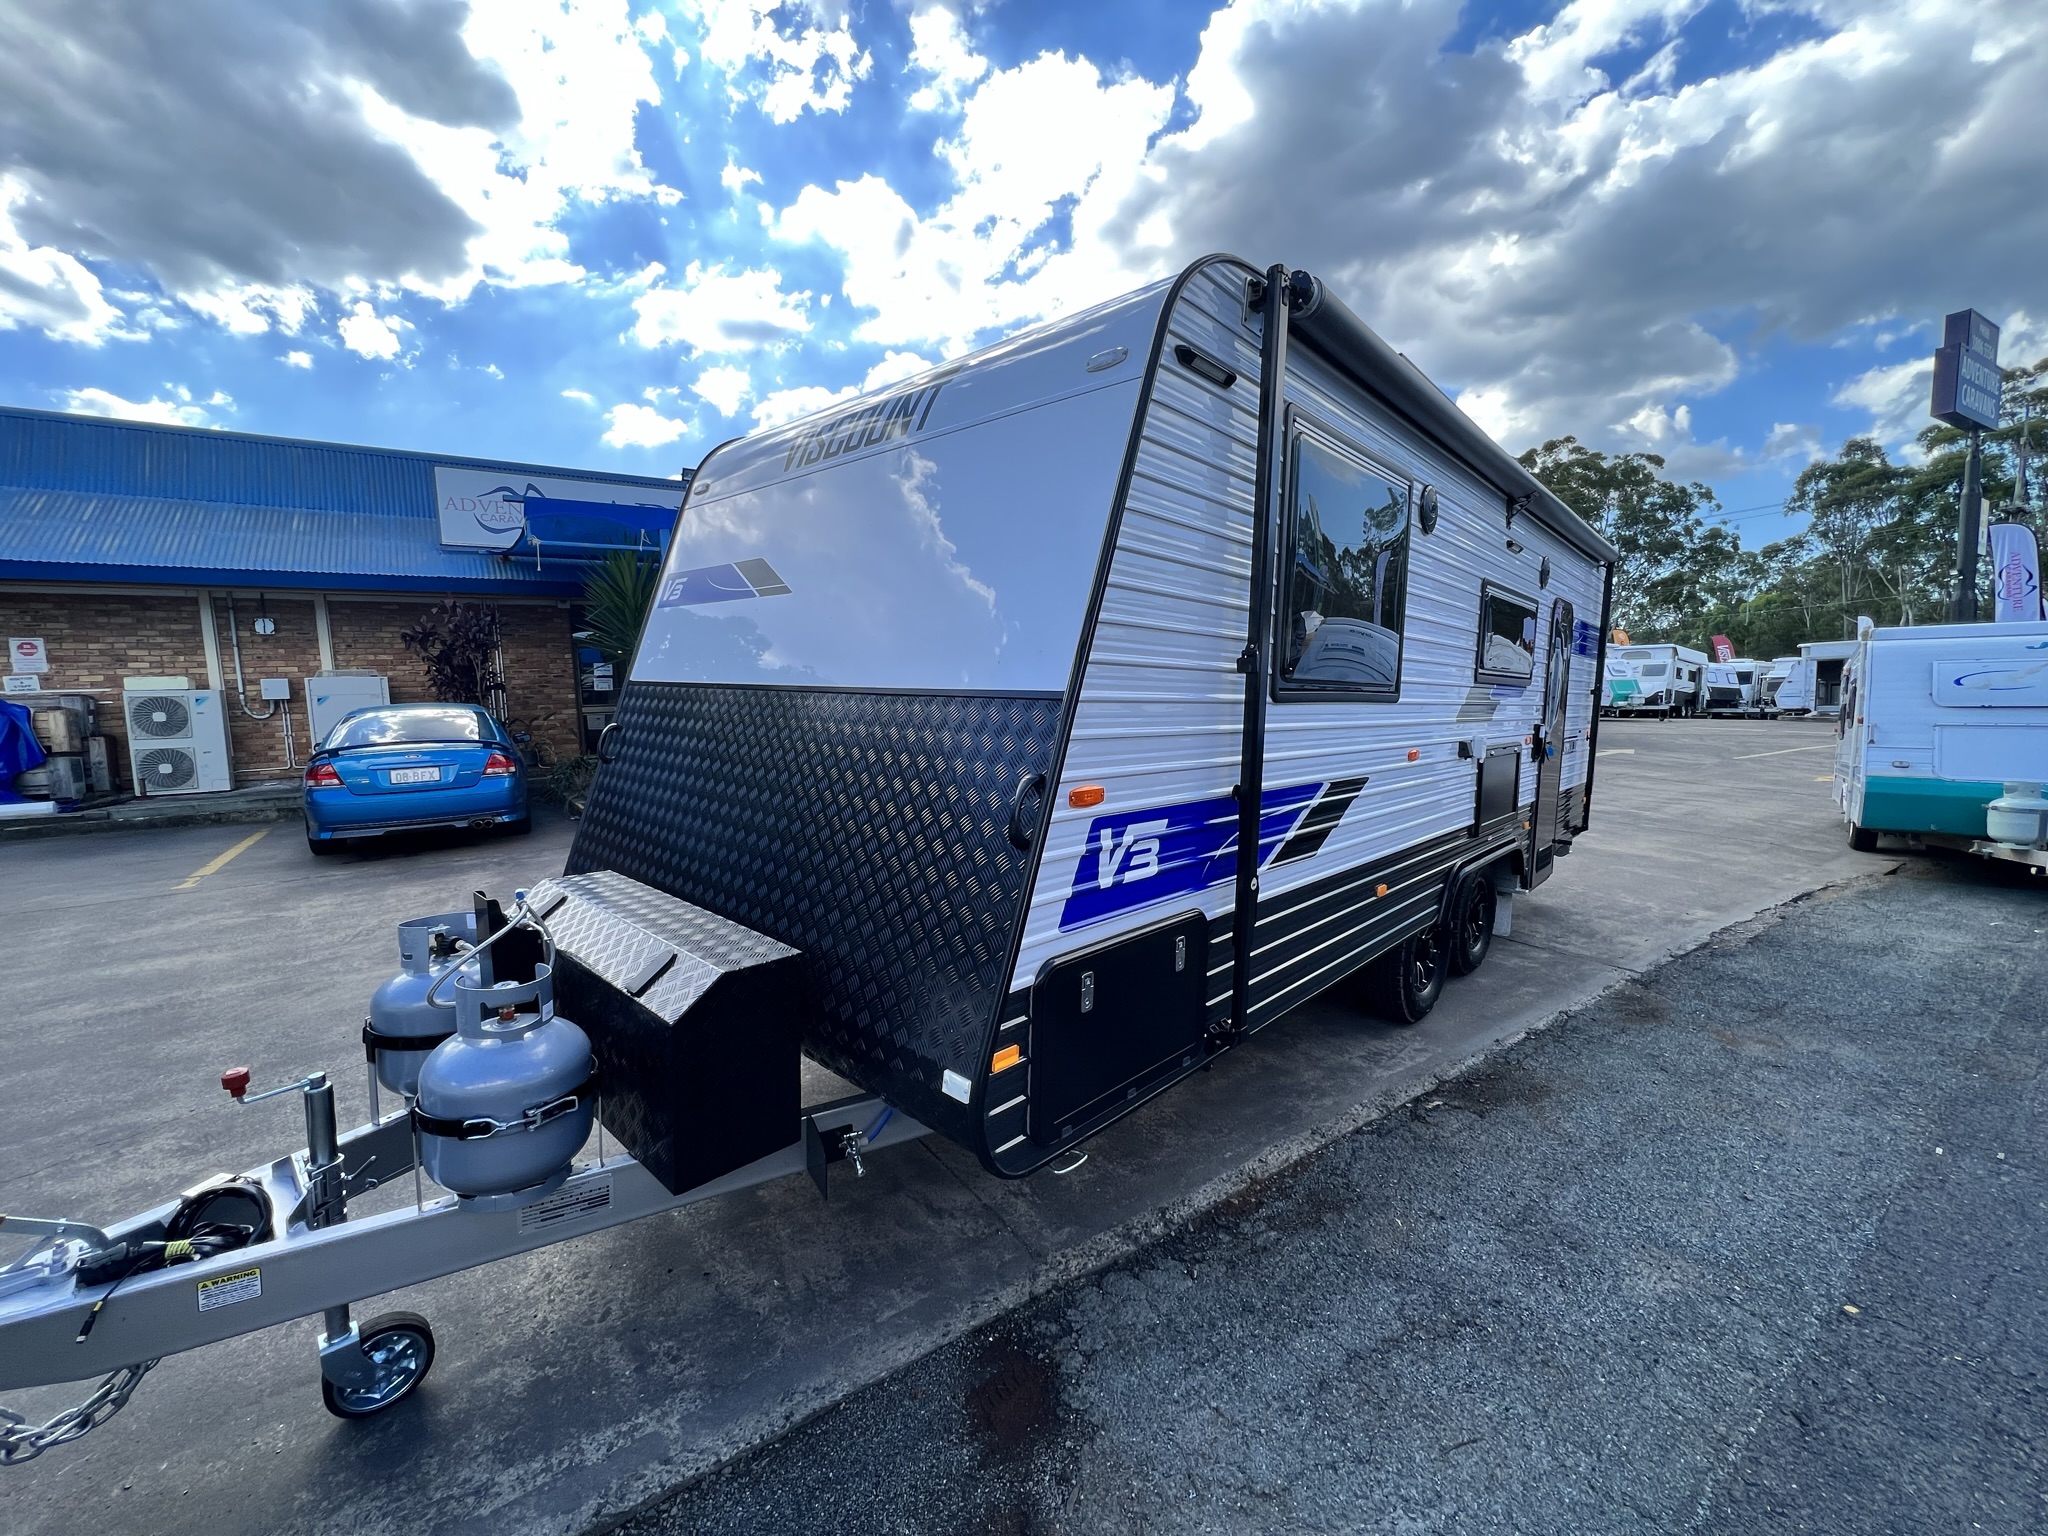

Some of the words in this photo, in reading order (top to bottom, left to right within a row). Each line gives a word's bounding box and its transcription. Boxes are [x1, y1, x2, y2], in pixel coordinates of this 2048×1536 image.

[1961, 355, 2000, 396] ADVENTURE
[784, 370, 959, 472] VISCOUNT
[1961, 384, 1996, 419] CARAVANS
[663, 577, 688, 601] V3
[2010, 551, 2023, 612] ADVENTURE
[1098, 818, 1169, 889] V3
[211, 1270, 257, 1286] WARNING
